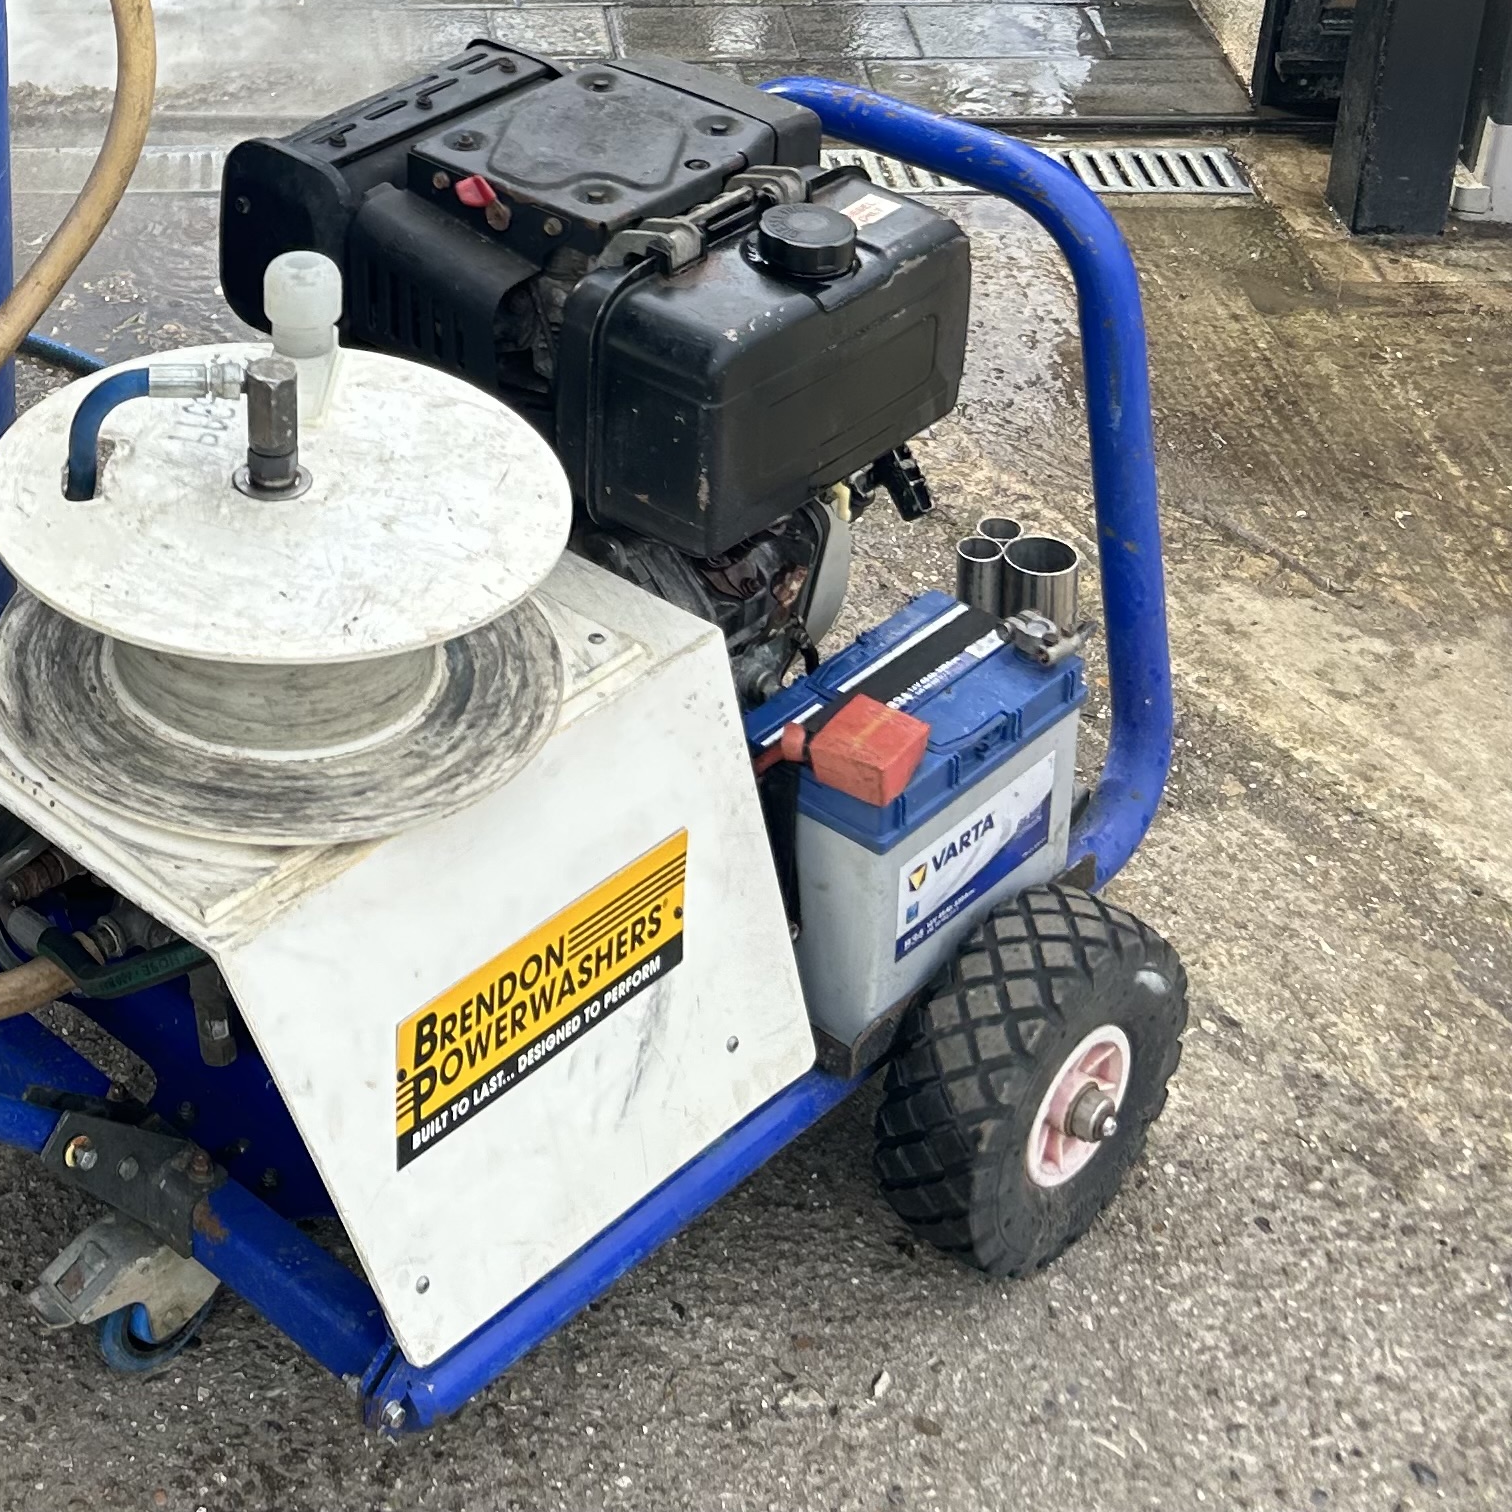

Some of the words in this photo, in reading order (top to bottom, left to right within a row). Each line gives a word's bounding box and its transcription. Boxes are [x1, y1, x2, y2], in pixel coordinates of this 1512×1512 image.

[931, 813, 994, 872] VARTA
[411, 1112, 449, 1151] BUILT
[450, 1096, 470, 1122] TO
[473, 1069, 516, 1106] LAST...
[517, 1014, 581, 1074] DESIGNED
[583, 999, 601, 1024] TO
[603, 954, 661, 1010] PERFORM
[413, 934, 565, 1071] BRENDON
[413, 903, 662, 1127] POWERWASHERS
